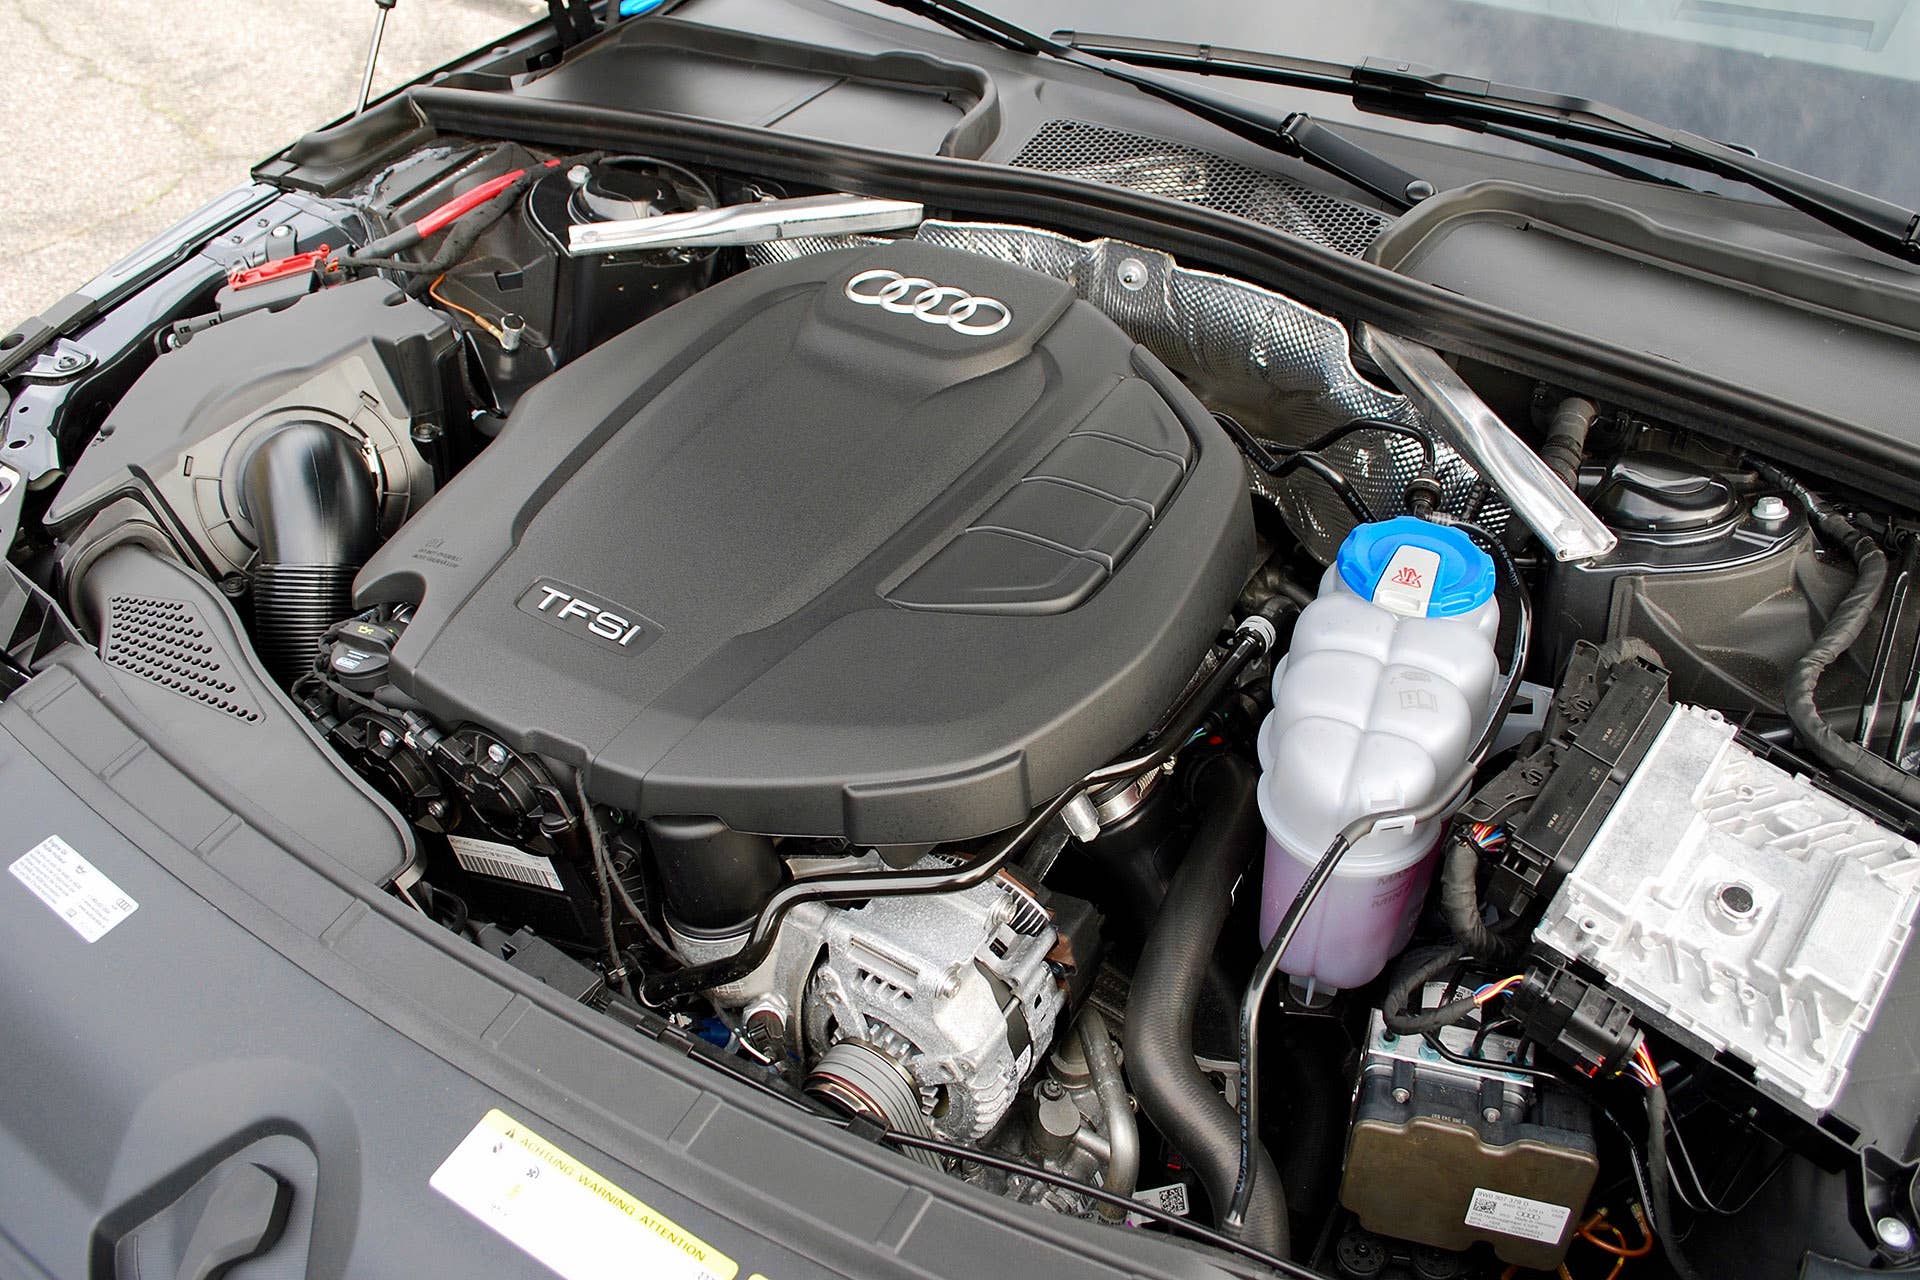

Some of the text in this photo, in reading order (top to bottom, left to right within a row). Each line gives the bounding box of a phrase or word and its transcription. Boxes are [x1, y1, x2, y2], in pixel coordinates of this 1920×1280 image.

[538, 586, 641, 646] TFSI
[518, 1137, 708, 1262] ACHTUNG WARNING ATTENTION
